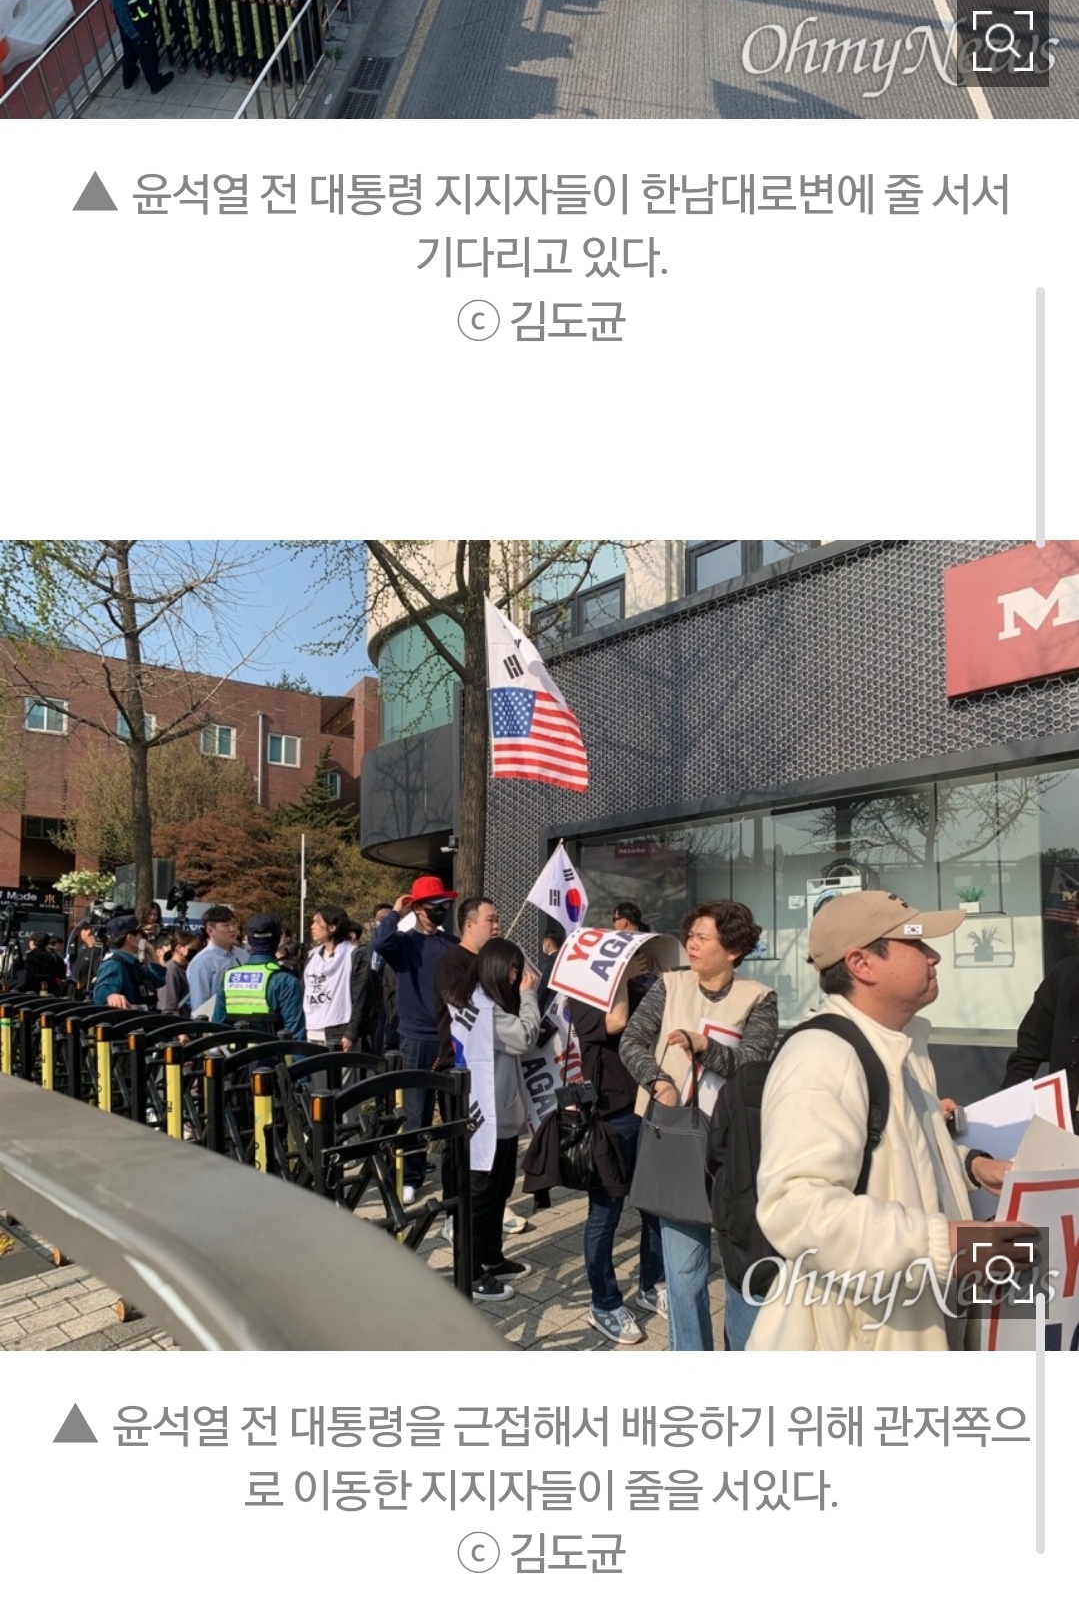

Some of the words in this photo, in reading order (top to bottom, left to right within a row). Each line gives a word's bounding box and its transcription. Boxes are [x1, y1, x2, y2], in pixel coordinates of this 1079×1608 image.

[131, 172, 249, 216] 윤석열
[259, 172, 298, 215] 전
[310, 172, 423, 217] 대통령
[434, 172, 629, 216] 지지자들이
[640, 172, 874, 216] 한남대로변에
[883, 173, 924, 216] 줄
[931, 172, 1009, 216] 서서
[416, 235, 573, 279] 기다리고
[582, 235, 669, 279] 있다.
[509, 299, 627, 343] 김도균
[112, 1404, 229, 1448] 윤석열
[240, 1404, 278, 1447] 전
[290, 1404, 446, 1449] 대통령을
[453, 1404, 609, 1448] 근접해서
[622, 1404, 775, 1449] 배웅하기
[787, 1404, 864, 1448] 위해
[873, 1404, 1032, 1448] 관저쪽으
[243, 1470, 285, 1507] 로
[294, 1468, 413, 1513] 이동한
[419, 1468, 614, 1512] 지지자들이
[624, 1468, 704, 1512] 줄을
[711, 1468, 839, 1512] 서있다.
[509, 1531, 627, 1575] 김도균
